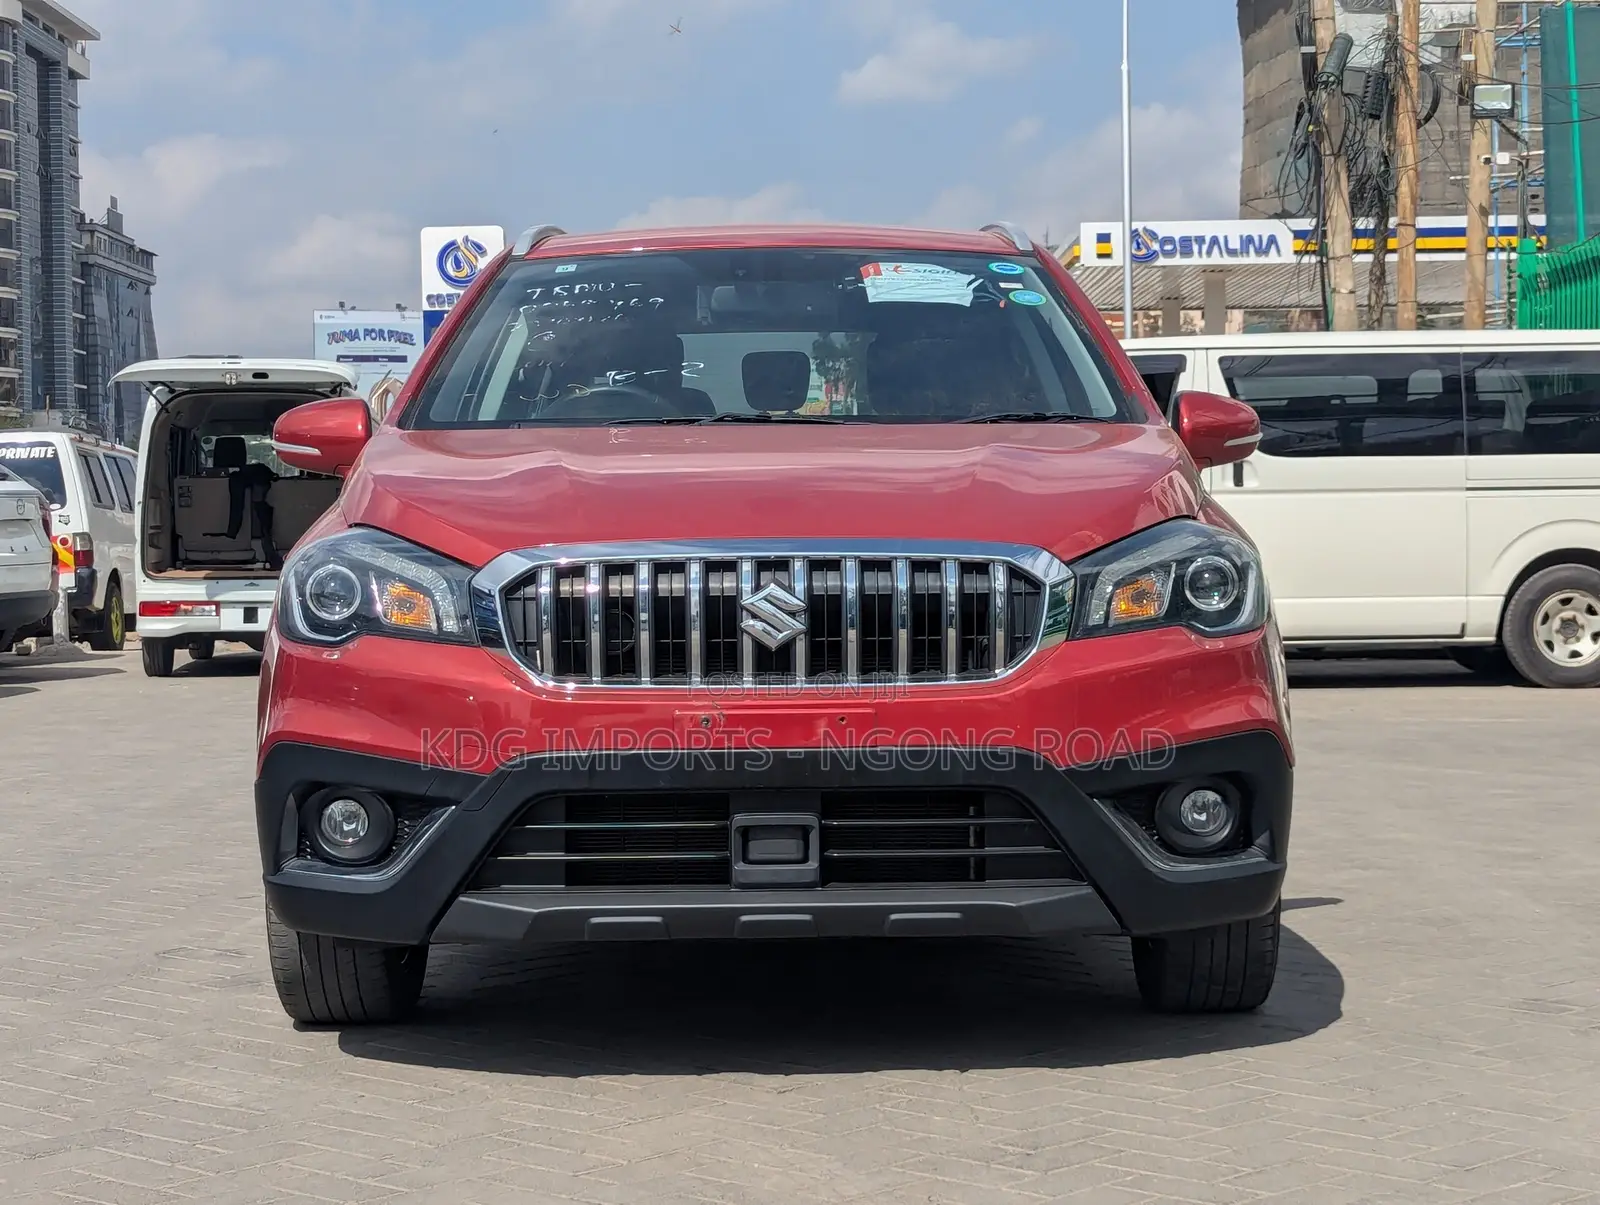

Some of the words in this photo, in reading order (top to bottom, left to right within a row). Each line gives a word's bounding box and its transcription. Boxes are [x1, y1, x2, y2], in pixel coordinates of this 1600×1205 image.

[1131, 226, 1282, 263] COSTALINA
[363, 328, 387, 342] FOR
[0, 446, 56, 459] PRIVATE
